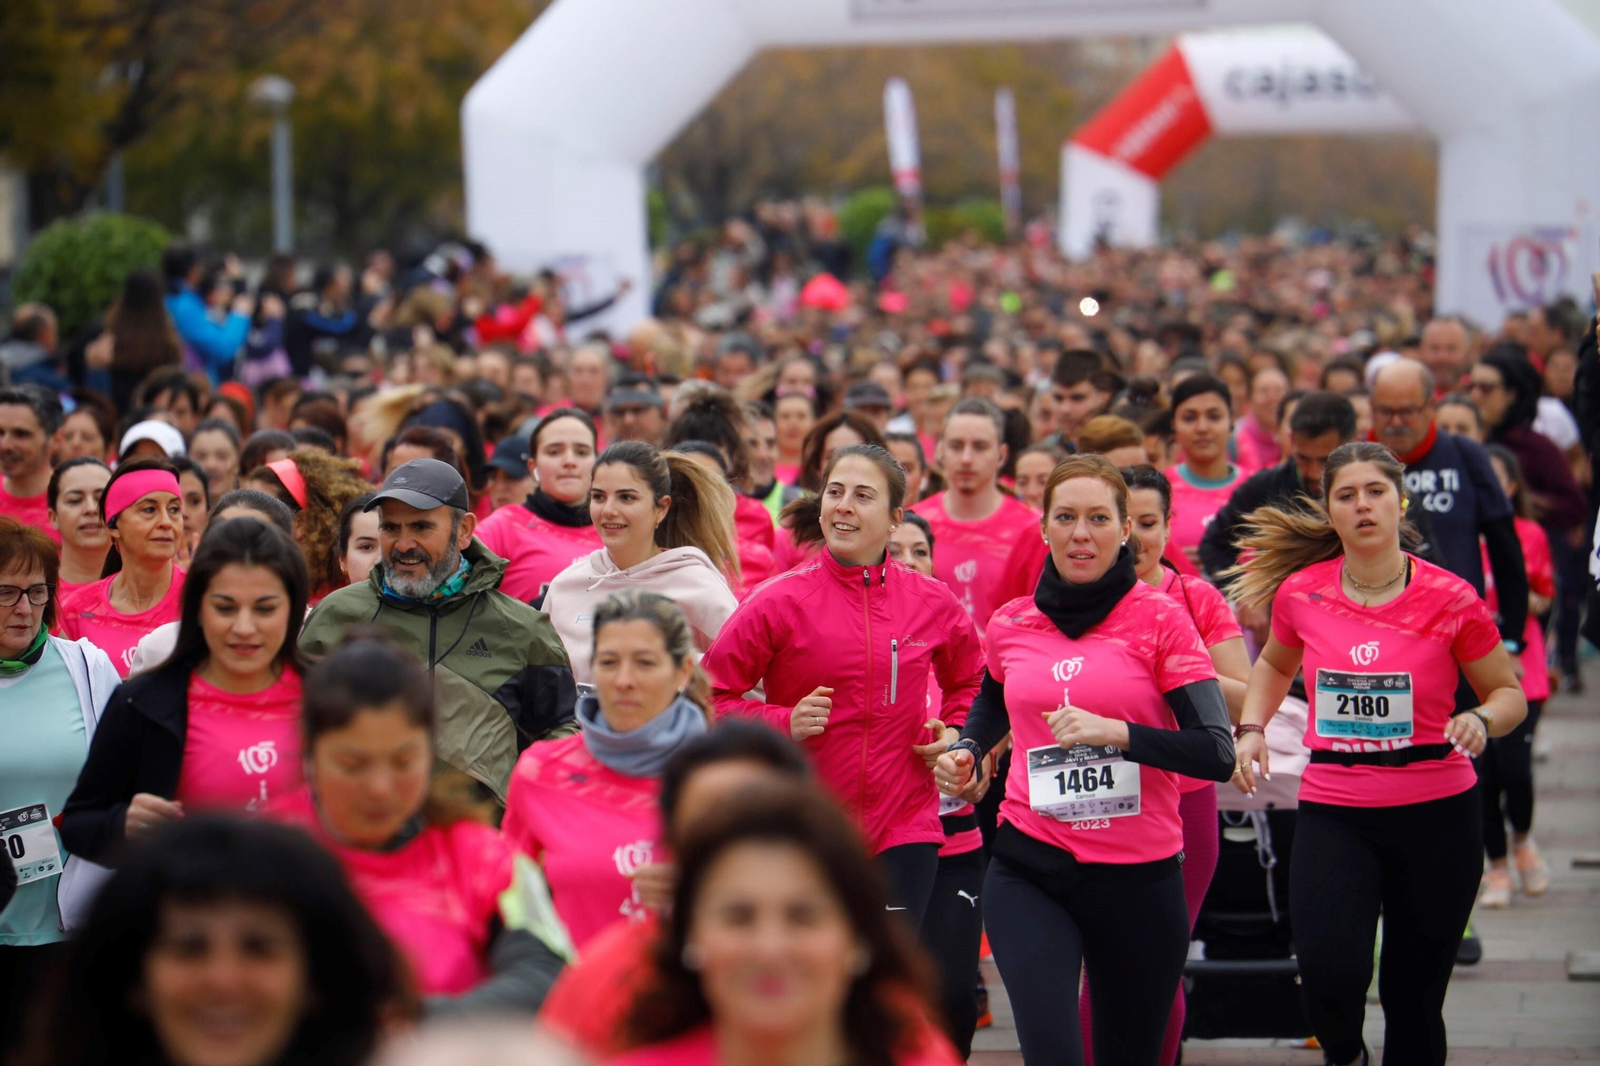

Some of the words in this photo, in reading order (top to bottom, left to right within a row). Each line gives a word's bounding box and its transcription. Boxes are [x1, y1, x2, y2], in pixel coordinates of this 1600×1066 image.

[1403, 469, 1436, 494] OR
[1438, 468, 1460, 493] TI
[466, 650, 492, 658] adidas
[1336, 694, 1390, 718] 2180
[1054, 765, 1115, 795] 1464
[1071, 818, 1111, 830] 2023
